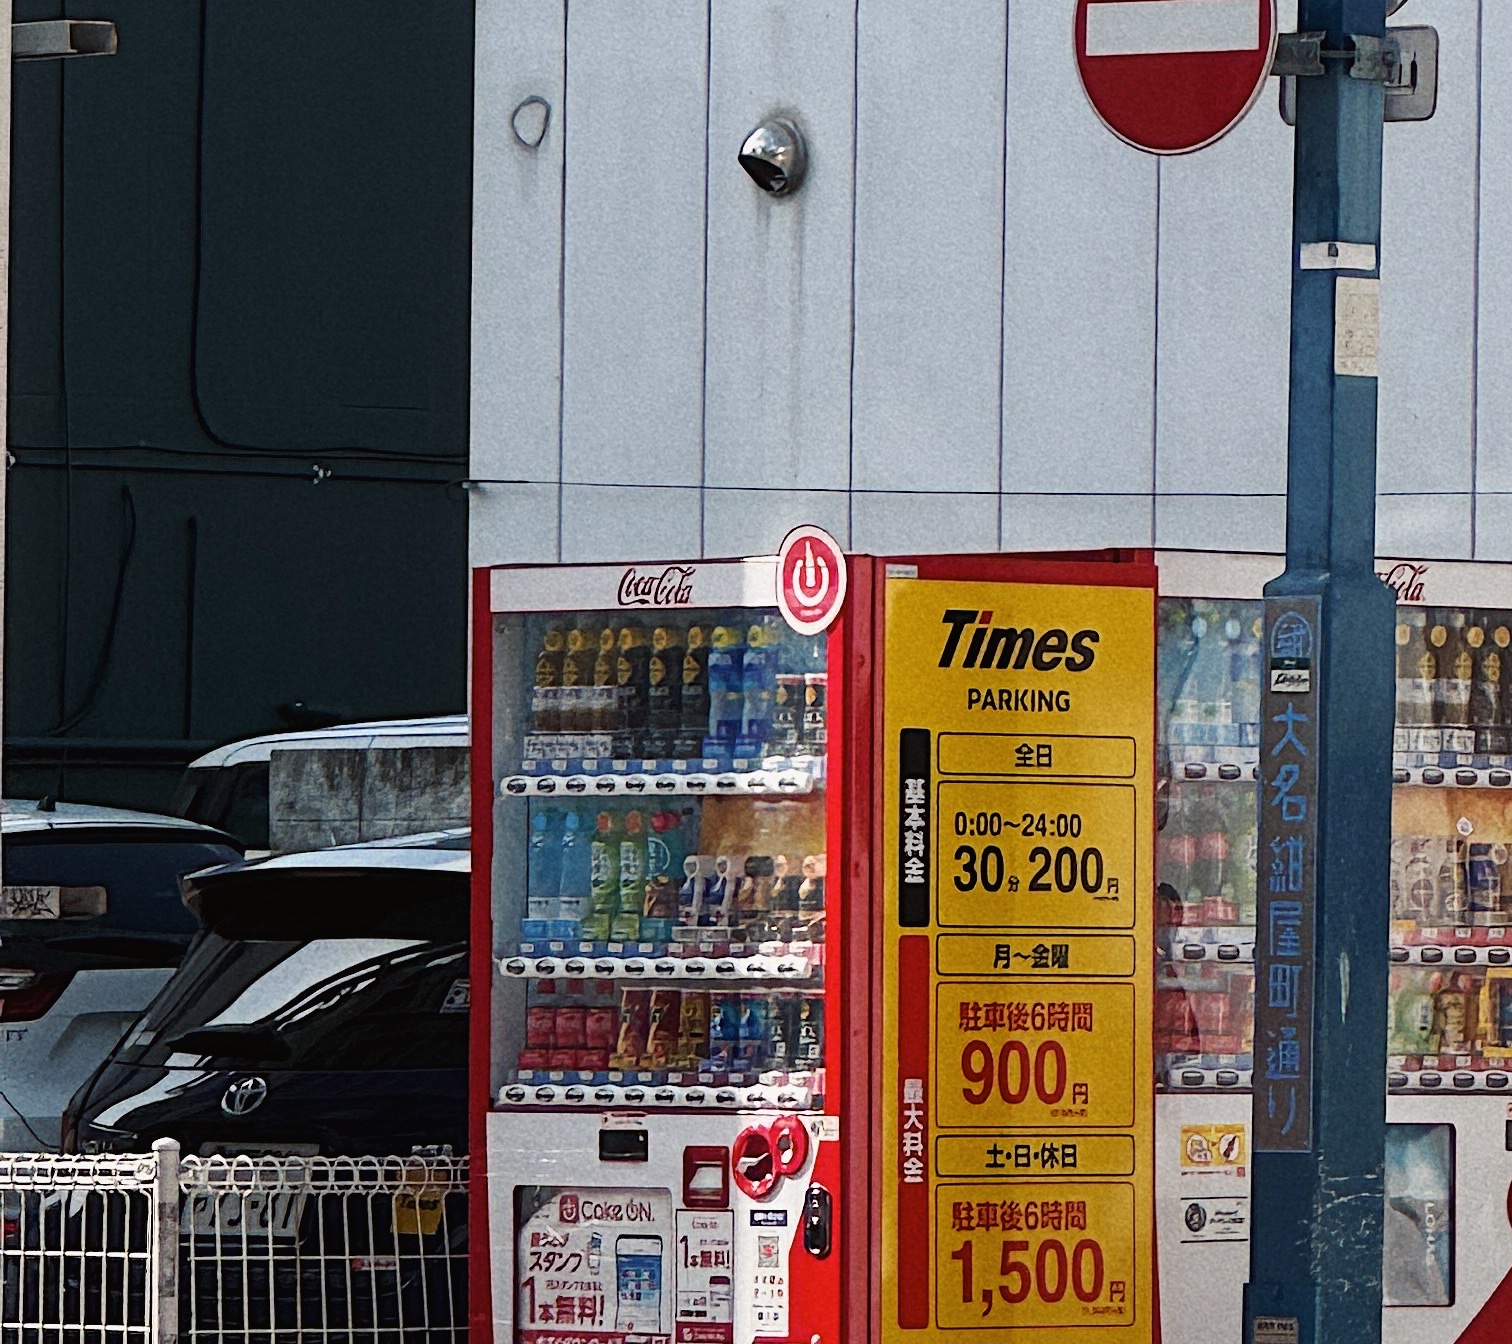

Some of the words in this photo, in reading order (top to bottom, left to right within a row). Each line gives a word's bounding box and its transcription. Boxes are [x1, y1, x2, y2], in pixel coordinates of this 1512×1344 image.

[938, 609, 1100, 672] Times
[967, 688, 1071, 713] PARKING
[1014, 743, 1053, 768] 全日
[904, 777, 926, 885] 基本料金
[958, 1001, 1094, 1033] 駐車後6時間
[960, 1039, 1089, 1106] 900円
[902, 1078, 925, 1184] 最大料金
[582, 1199, 624, 1222] Coke
[951, 1200, 1087, 1232] 駐車後6時間
[951, 1237, 1127, 1318] 1,500円
